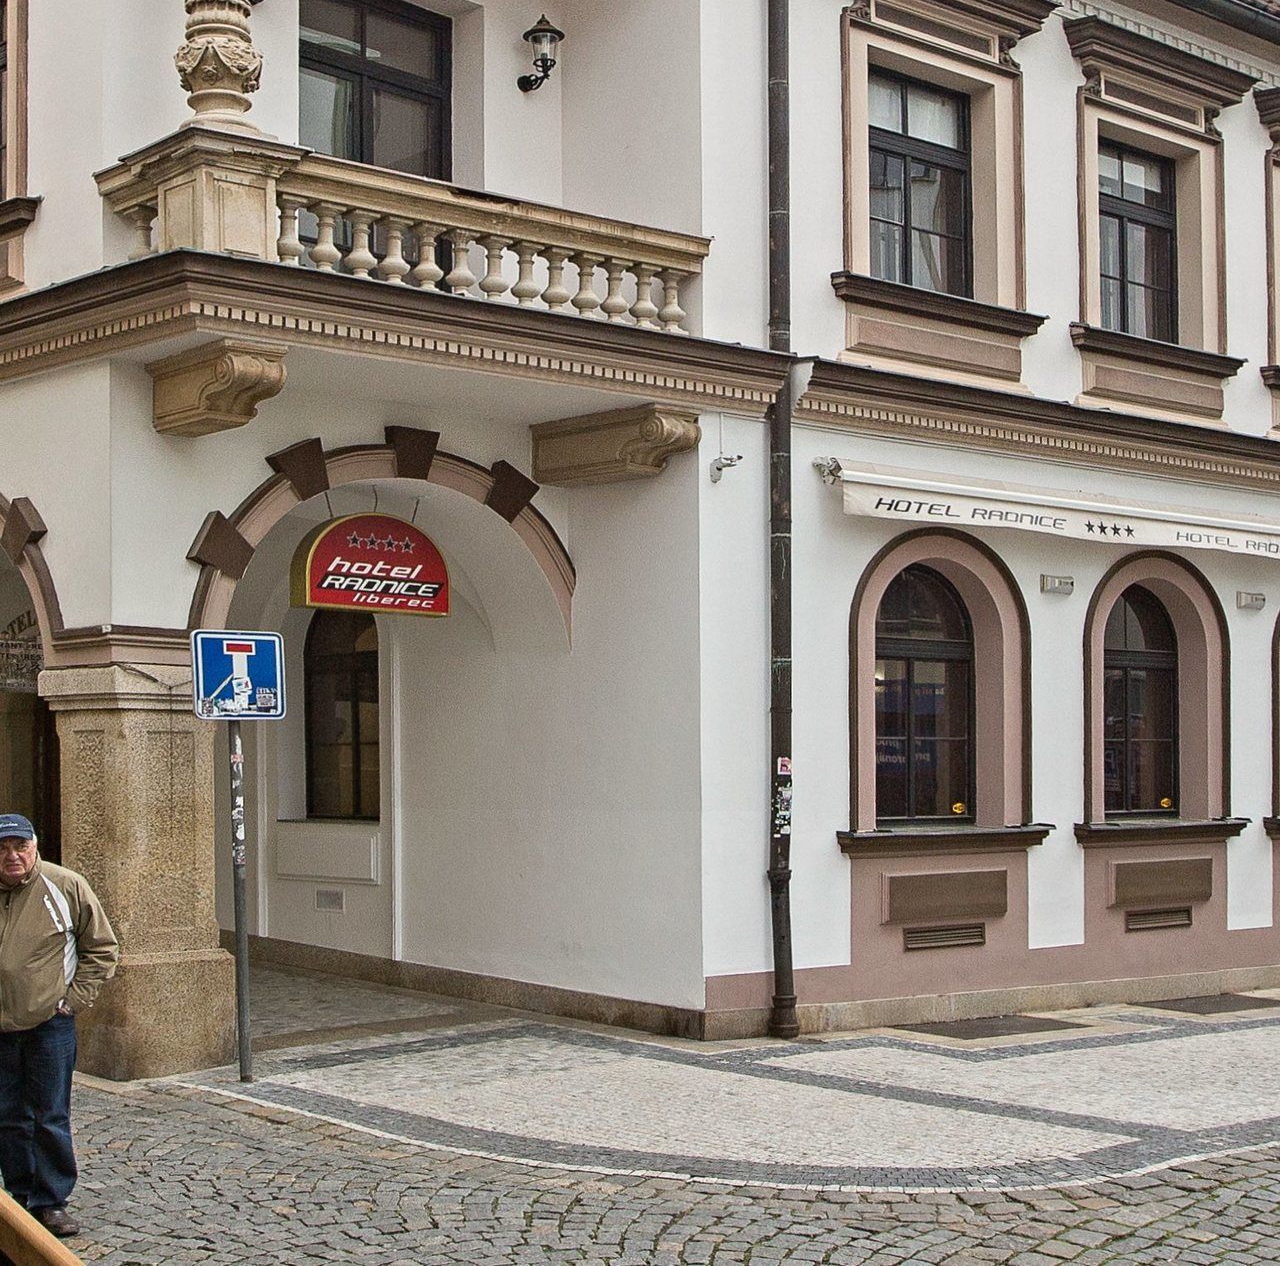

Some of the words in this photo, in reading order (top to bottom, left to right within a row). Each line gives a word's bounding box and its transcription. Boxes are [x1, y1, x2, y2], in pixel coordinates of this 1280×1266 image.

[874, 497, 960, 518] HOTEL
[971, 508, 1067, 530] RADNICE
[1176, 531, 1238, 548] HOTEL
[327, 557, 423, 579] hotel
[322, 575, 439, 597] RADNICE
[353, 592, 435, 608] liberec
